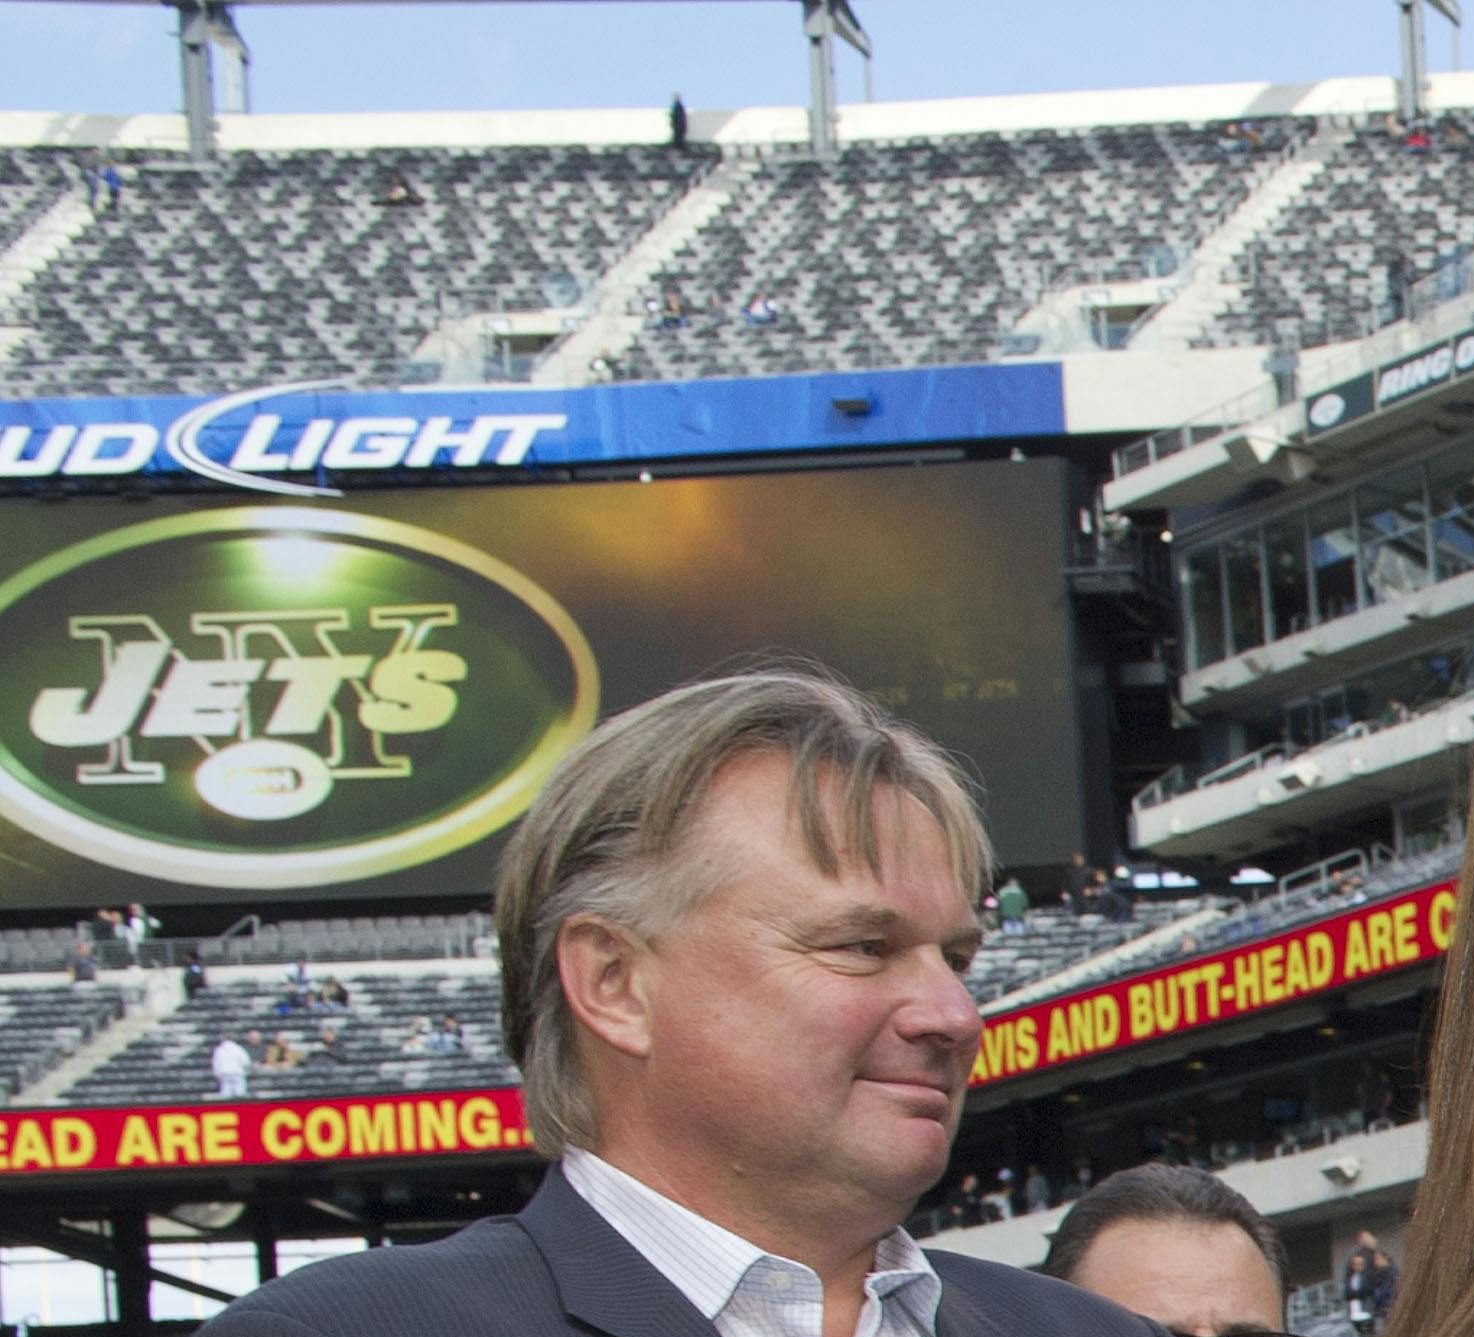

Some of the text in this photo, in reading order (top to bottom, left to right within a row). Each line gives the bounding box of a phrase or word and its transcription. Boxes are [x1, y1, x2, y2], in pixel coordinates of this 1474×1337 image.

[1378, 348, 1452, 400] RING
[0, 414, 568, 477] UD LIGHT
[29, 640, 468, 747] JETS
[1047, 997, 1120, 1063] AND
[1129, 932, 1334, 1040] BUTT-HEAD
[1345, 903, 1422, 983] ARE
[117, 1112, 241, 1165] ARE
